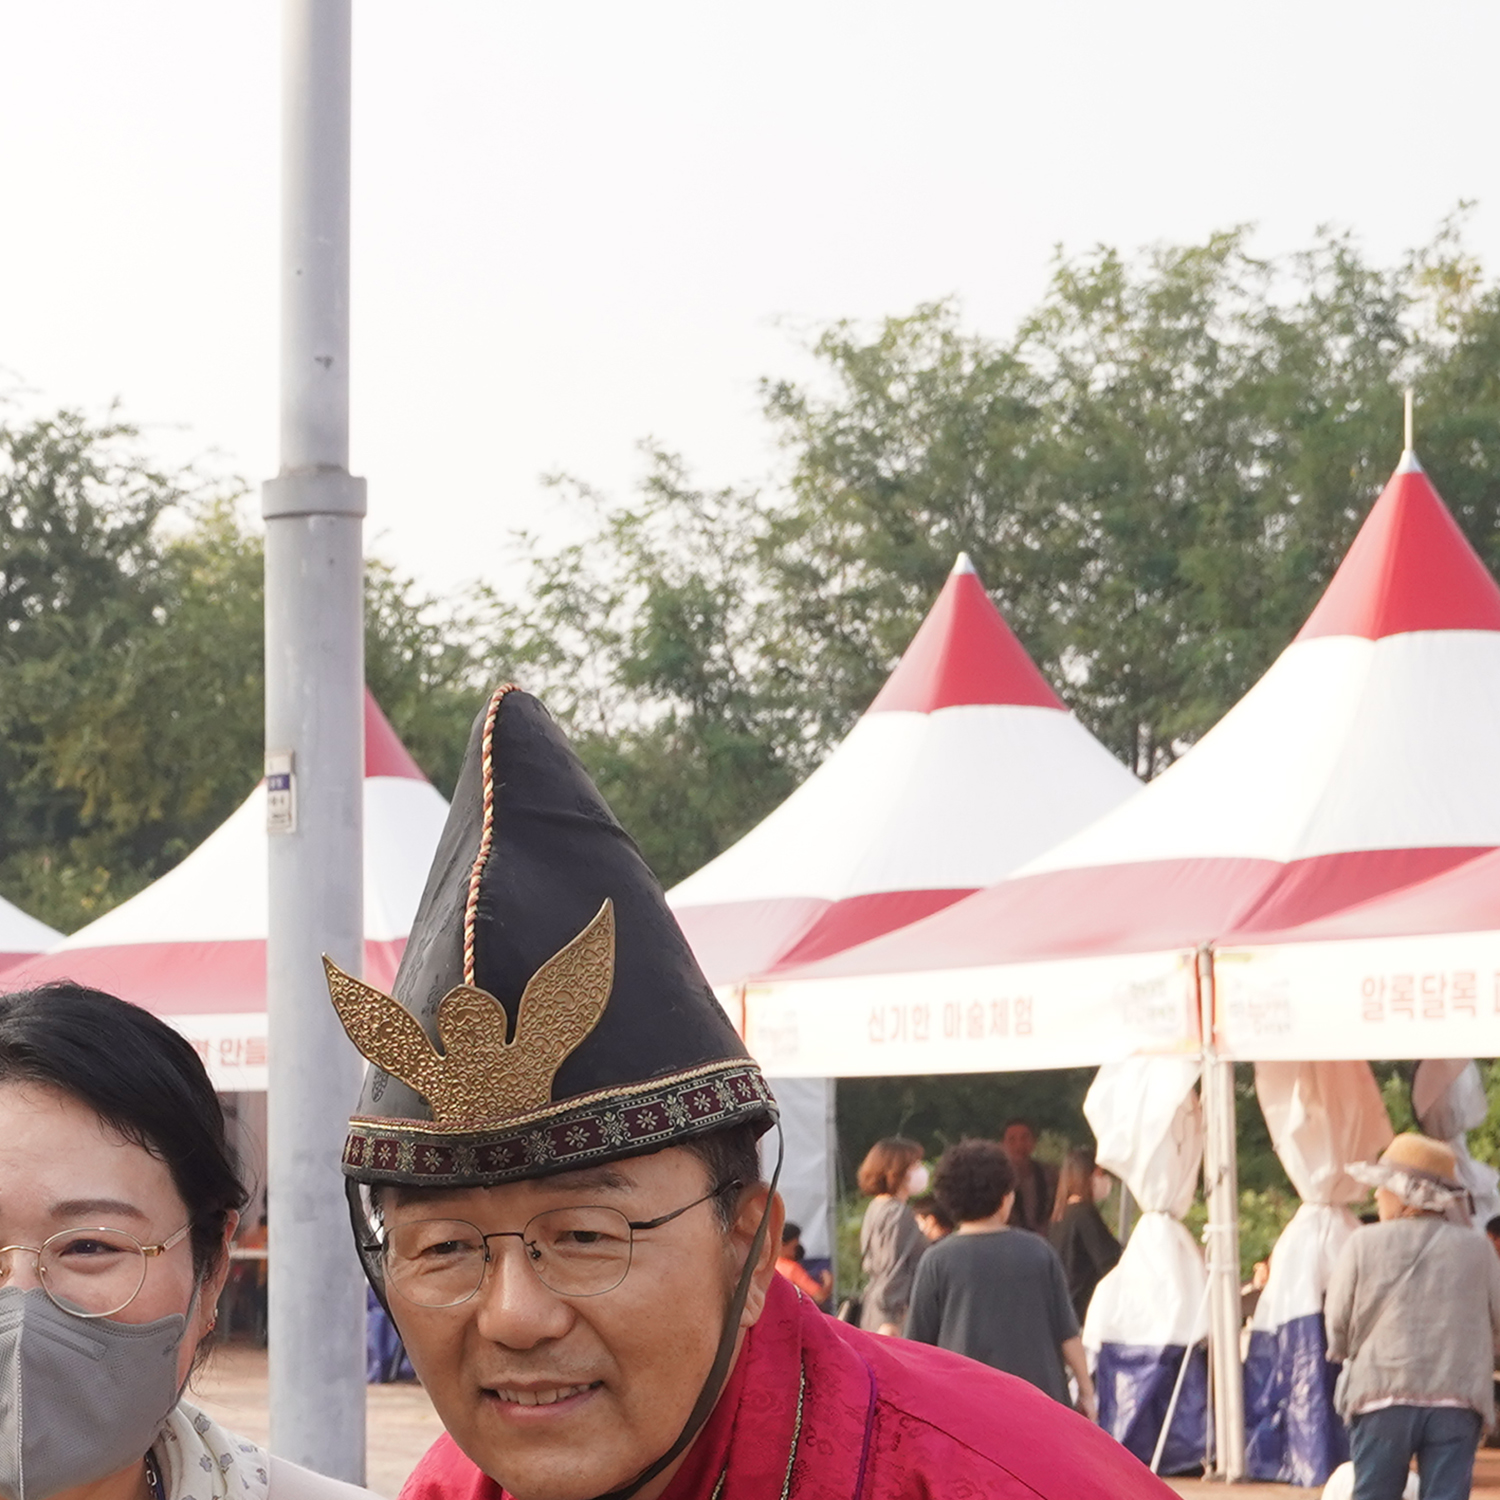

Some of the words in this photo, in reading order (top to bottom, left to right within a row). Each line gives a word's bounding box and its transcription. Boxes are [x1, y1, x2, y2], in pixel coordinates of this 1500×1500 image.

[1361, 971, 1477, 1021] 알록달록
[868, 1002, 931, 1044] 신기한
[219, 1036, 268, 1068] 만들
